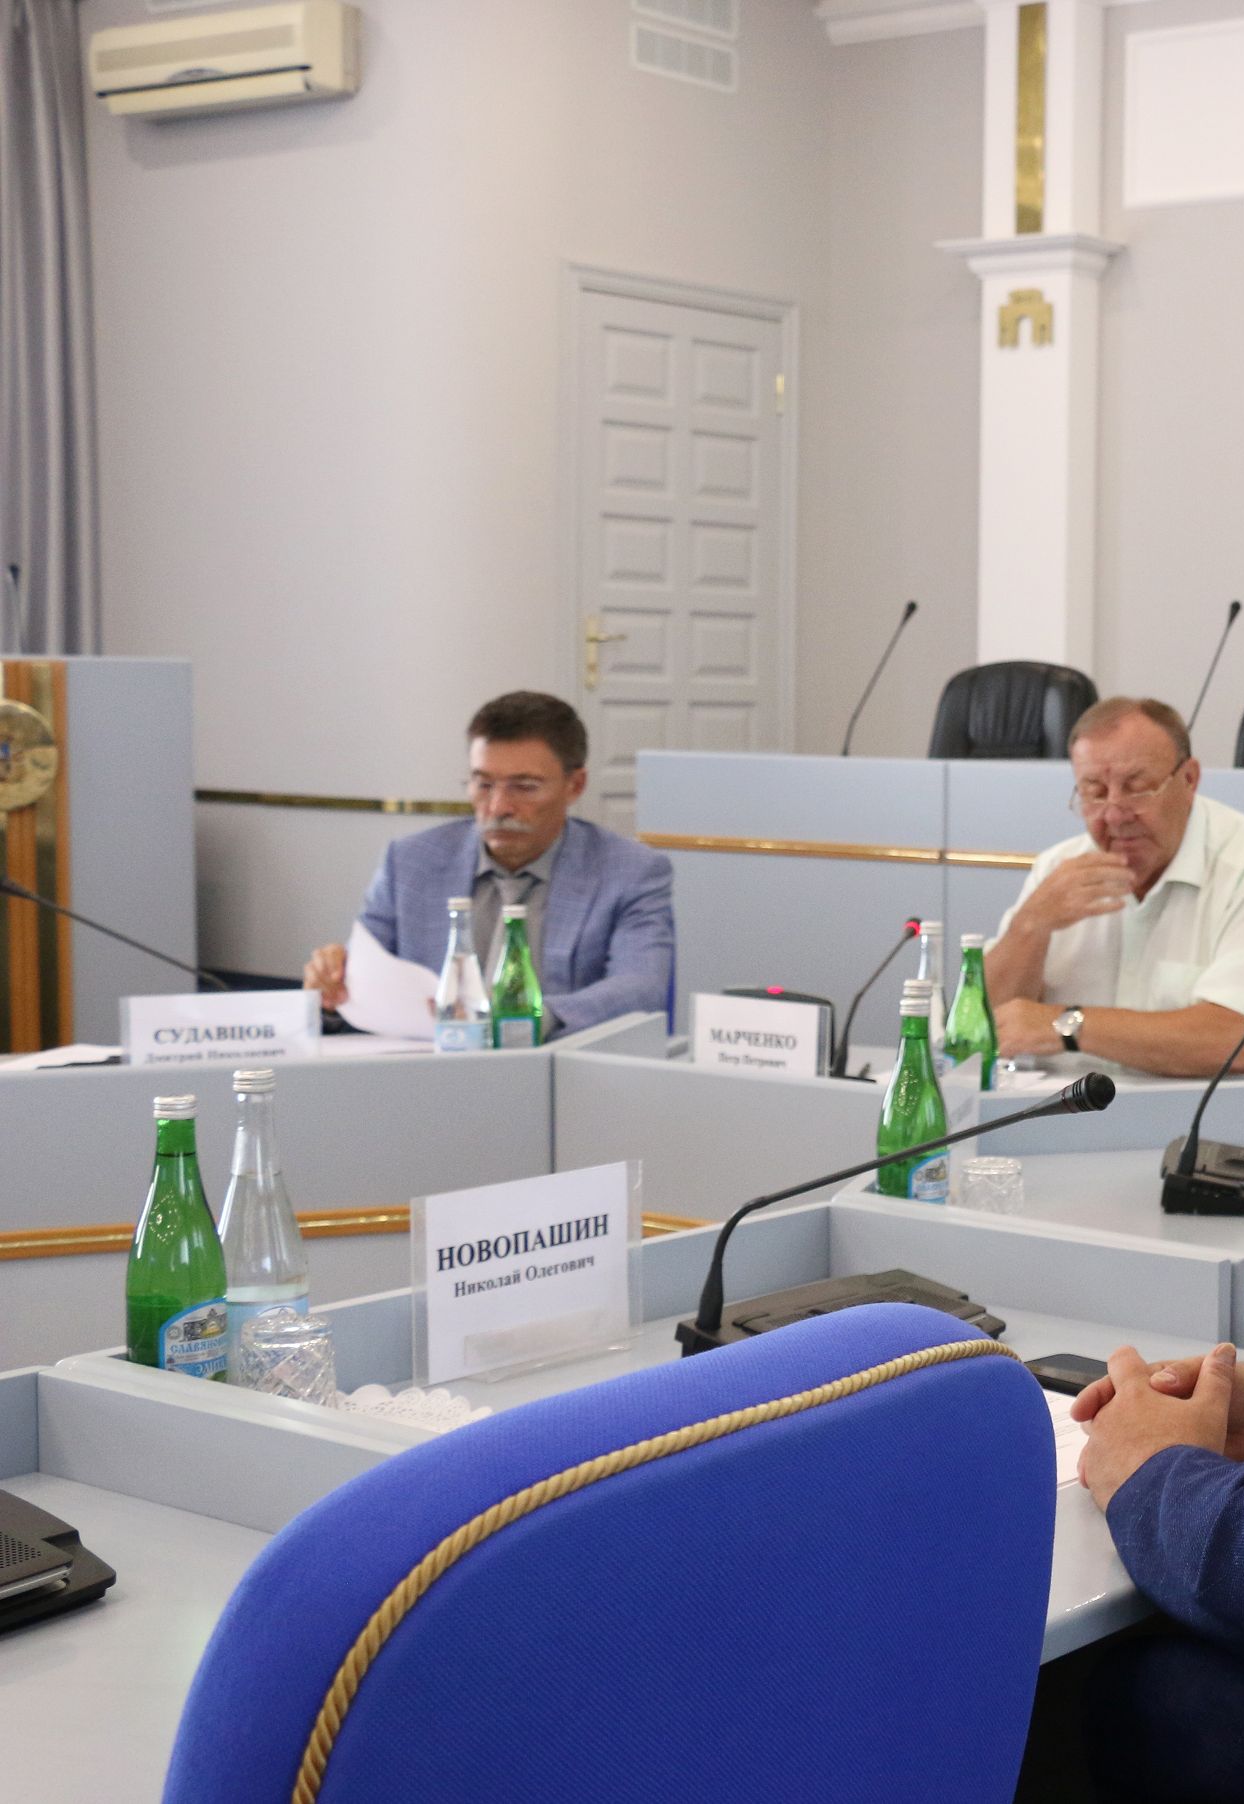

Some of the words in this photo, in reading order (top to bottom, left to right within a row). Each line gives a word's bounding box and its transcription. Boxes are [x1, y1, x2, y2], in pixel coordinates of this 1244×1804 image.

[710, 1029, 797, 1049] МАРЧЕНКО
[436, 1213, 609, 1272] НОВОПАШИН
[453, 1268, 521, 1298] Николай
[525, 1255, 596, 1282] Олегович
